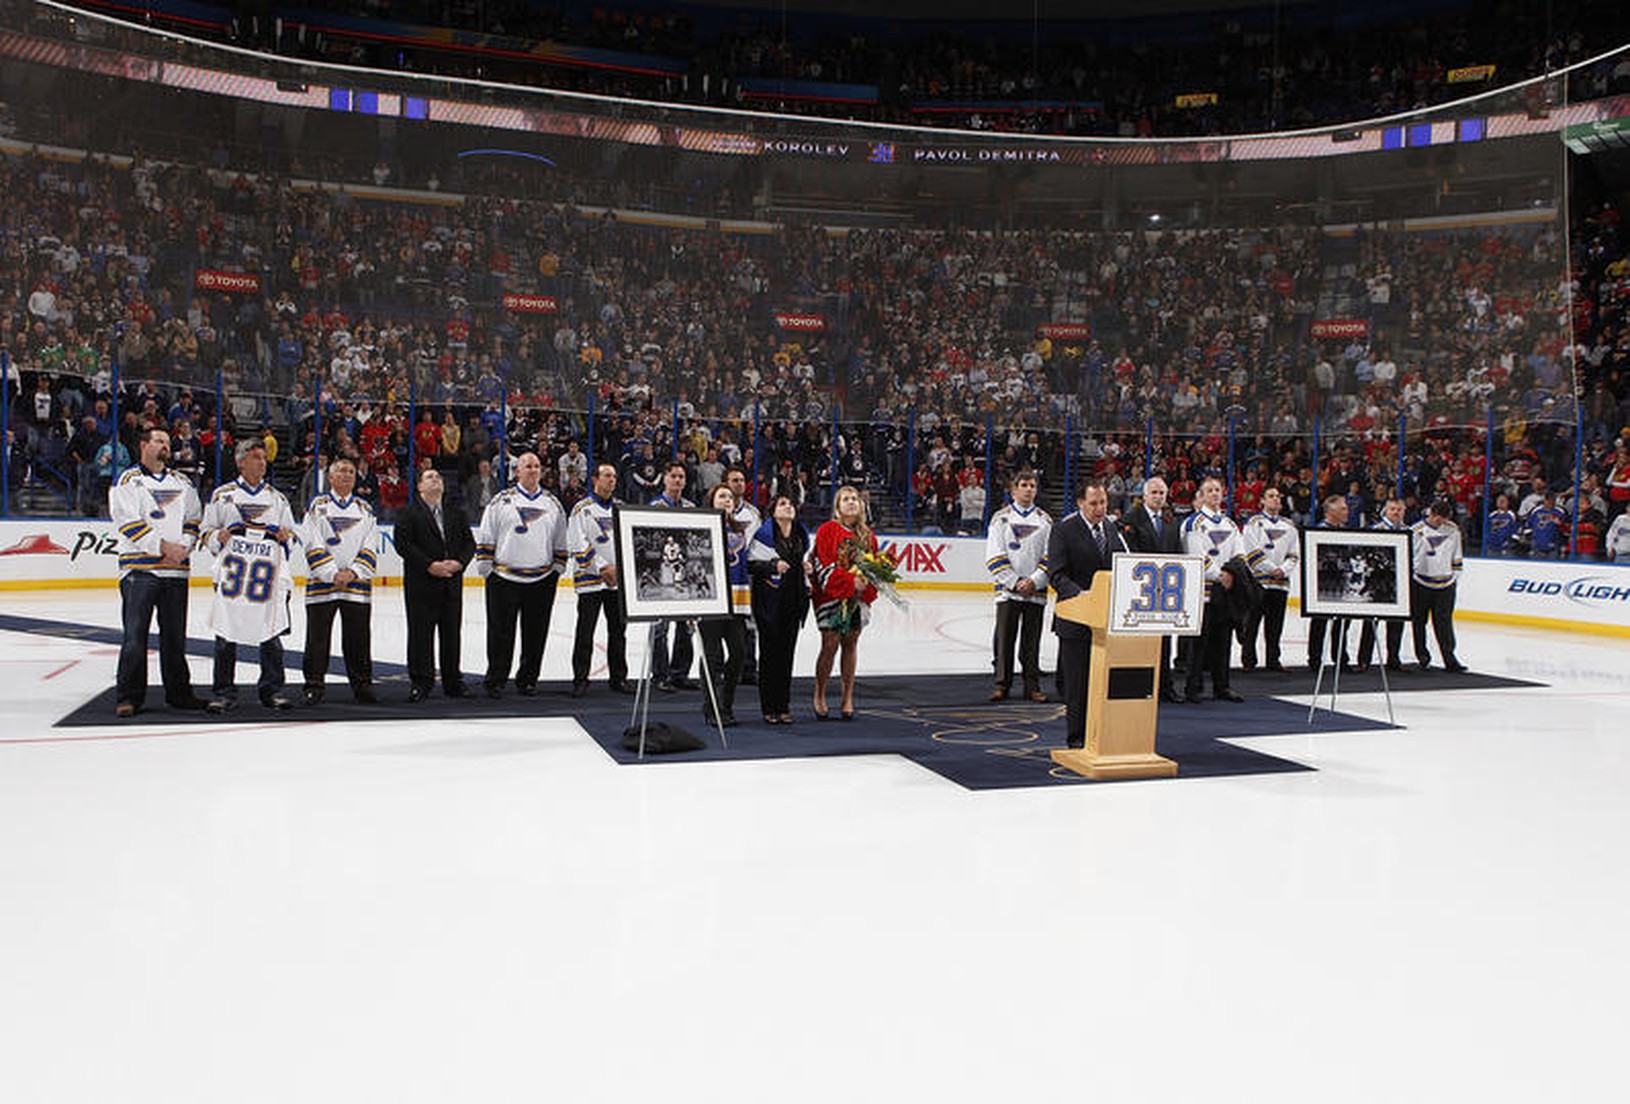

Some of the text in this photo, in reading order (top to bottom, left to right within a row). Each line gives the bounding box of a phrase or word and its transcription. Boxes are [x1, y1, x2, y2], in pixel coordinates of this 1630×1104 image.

[763, 141, 849, 156] KOROLEV
[914, 150, 1060, 161] PAVOL DEMITRA
[215, 275, 259, 290] TOYOTA
[519, 298, 556, 309] TOYOTA
[788, 318, 824, 327] TOYOTA
[1327, 324, 1366, 334] TOYOTA
[70, 531, 119, 562] Piz
[231, 540, 272, 557] DEMITRA
[220, 554, 275, 604] 38
[1131, 561, 1187, 613] 38
[1507, 579, 1630, 601] BUD LIGH
